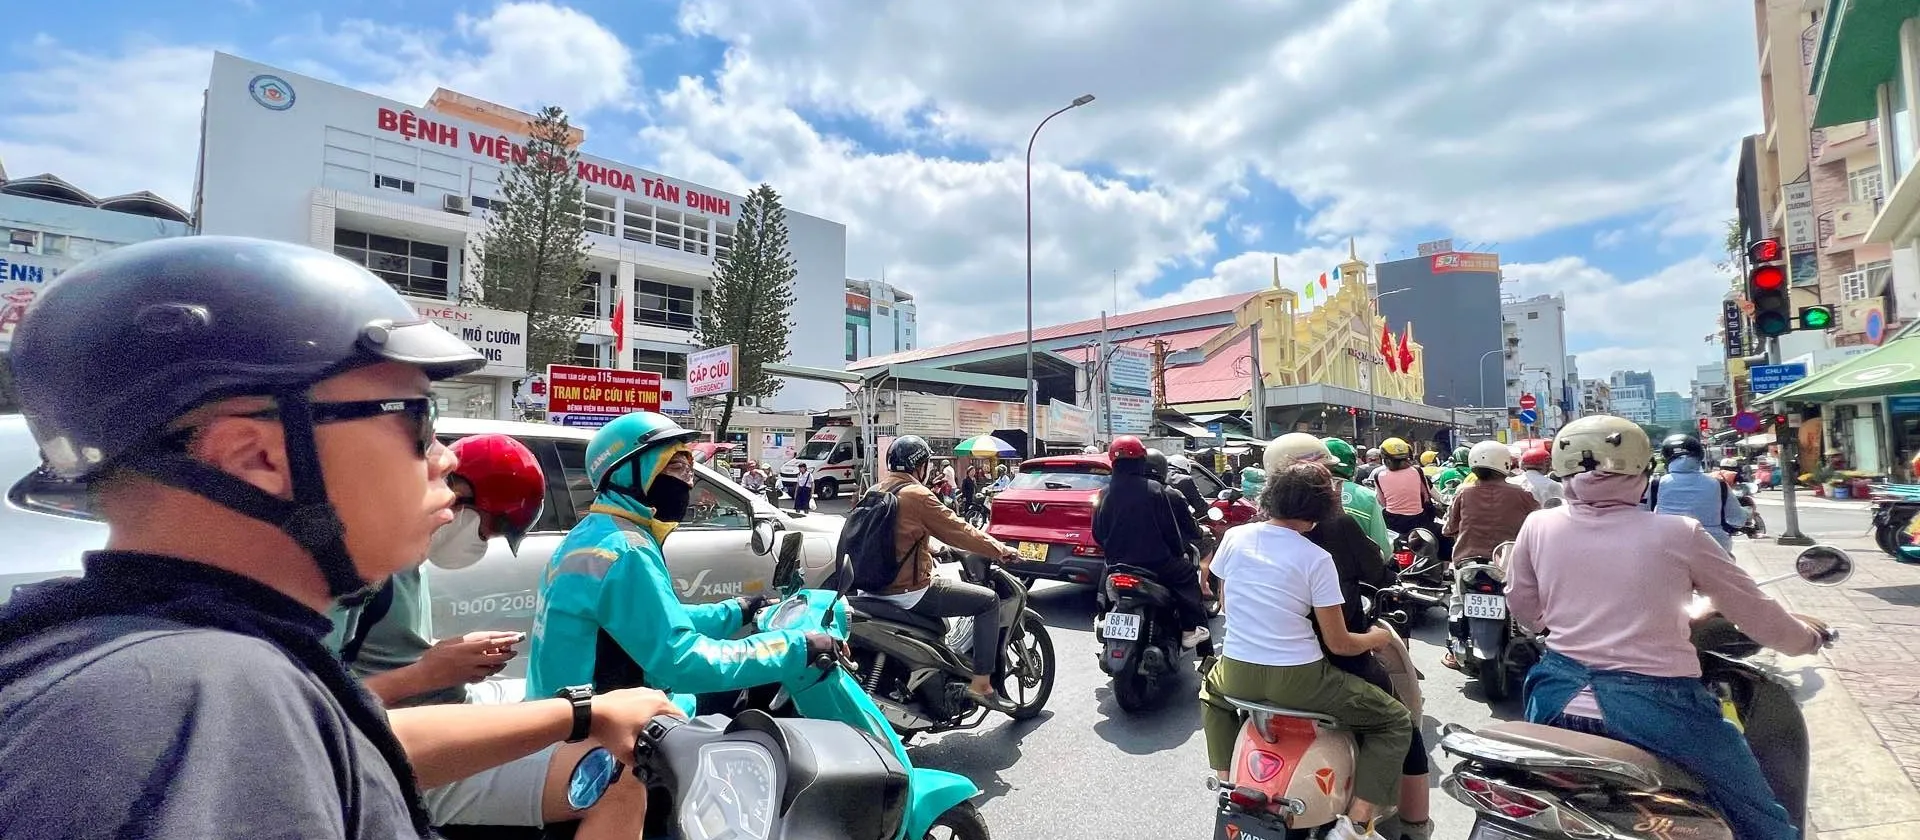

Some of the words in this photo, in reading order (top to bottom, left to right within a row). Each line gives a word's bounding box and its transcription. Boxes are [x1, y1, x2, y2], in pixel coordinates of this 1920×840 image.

[378, 107, 458, 149] BỆNH
[468, 131, 528, 165] VIỆN
[577, 161, 636, 193] KHOA
[641, 178, 680, 204] TÂN
[685, 190, 730, 217] ĐỊNH
[417, 307, 472, 320] UYÊN:
[1727, 303, 1740, 355] HUSTLE
[486, 329, 520, 345] CƯỜM
[597, 371, 612, 383] 115
[690, 362, 707, 383] CẤP
[710, 360, 729, 379] CỨU
[553, 385, 580, 402] TRẠM
[583, 383, 601, 401] CẤP
[605, 386, 622, 402] CỨU
[625, 388, 635, 405] VỆ
[638, 391, 658, 404] TINH
[380, 402, 405, 411] VANS
[702, 582, 742, 596] XANH
[450, 599, 496, 616] 1900
[501, 595, 537, 611] 208
[1471, 596, 1498, 606] 59-V1
[1467, 606, 1502, 617] 893.57
[1110, 615, 1134, 626] 68-NA
